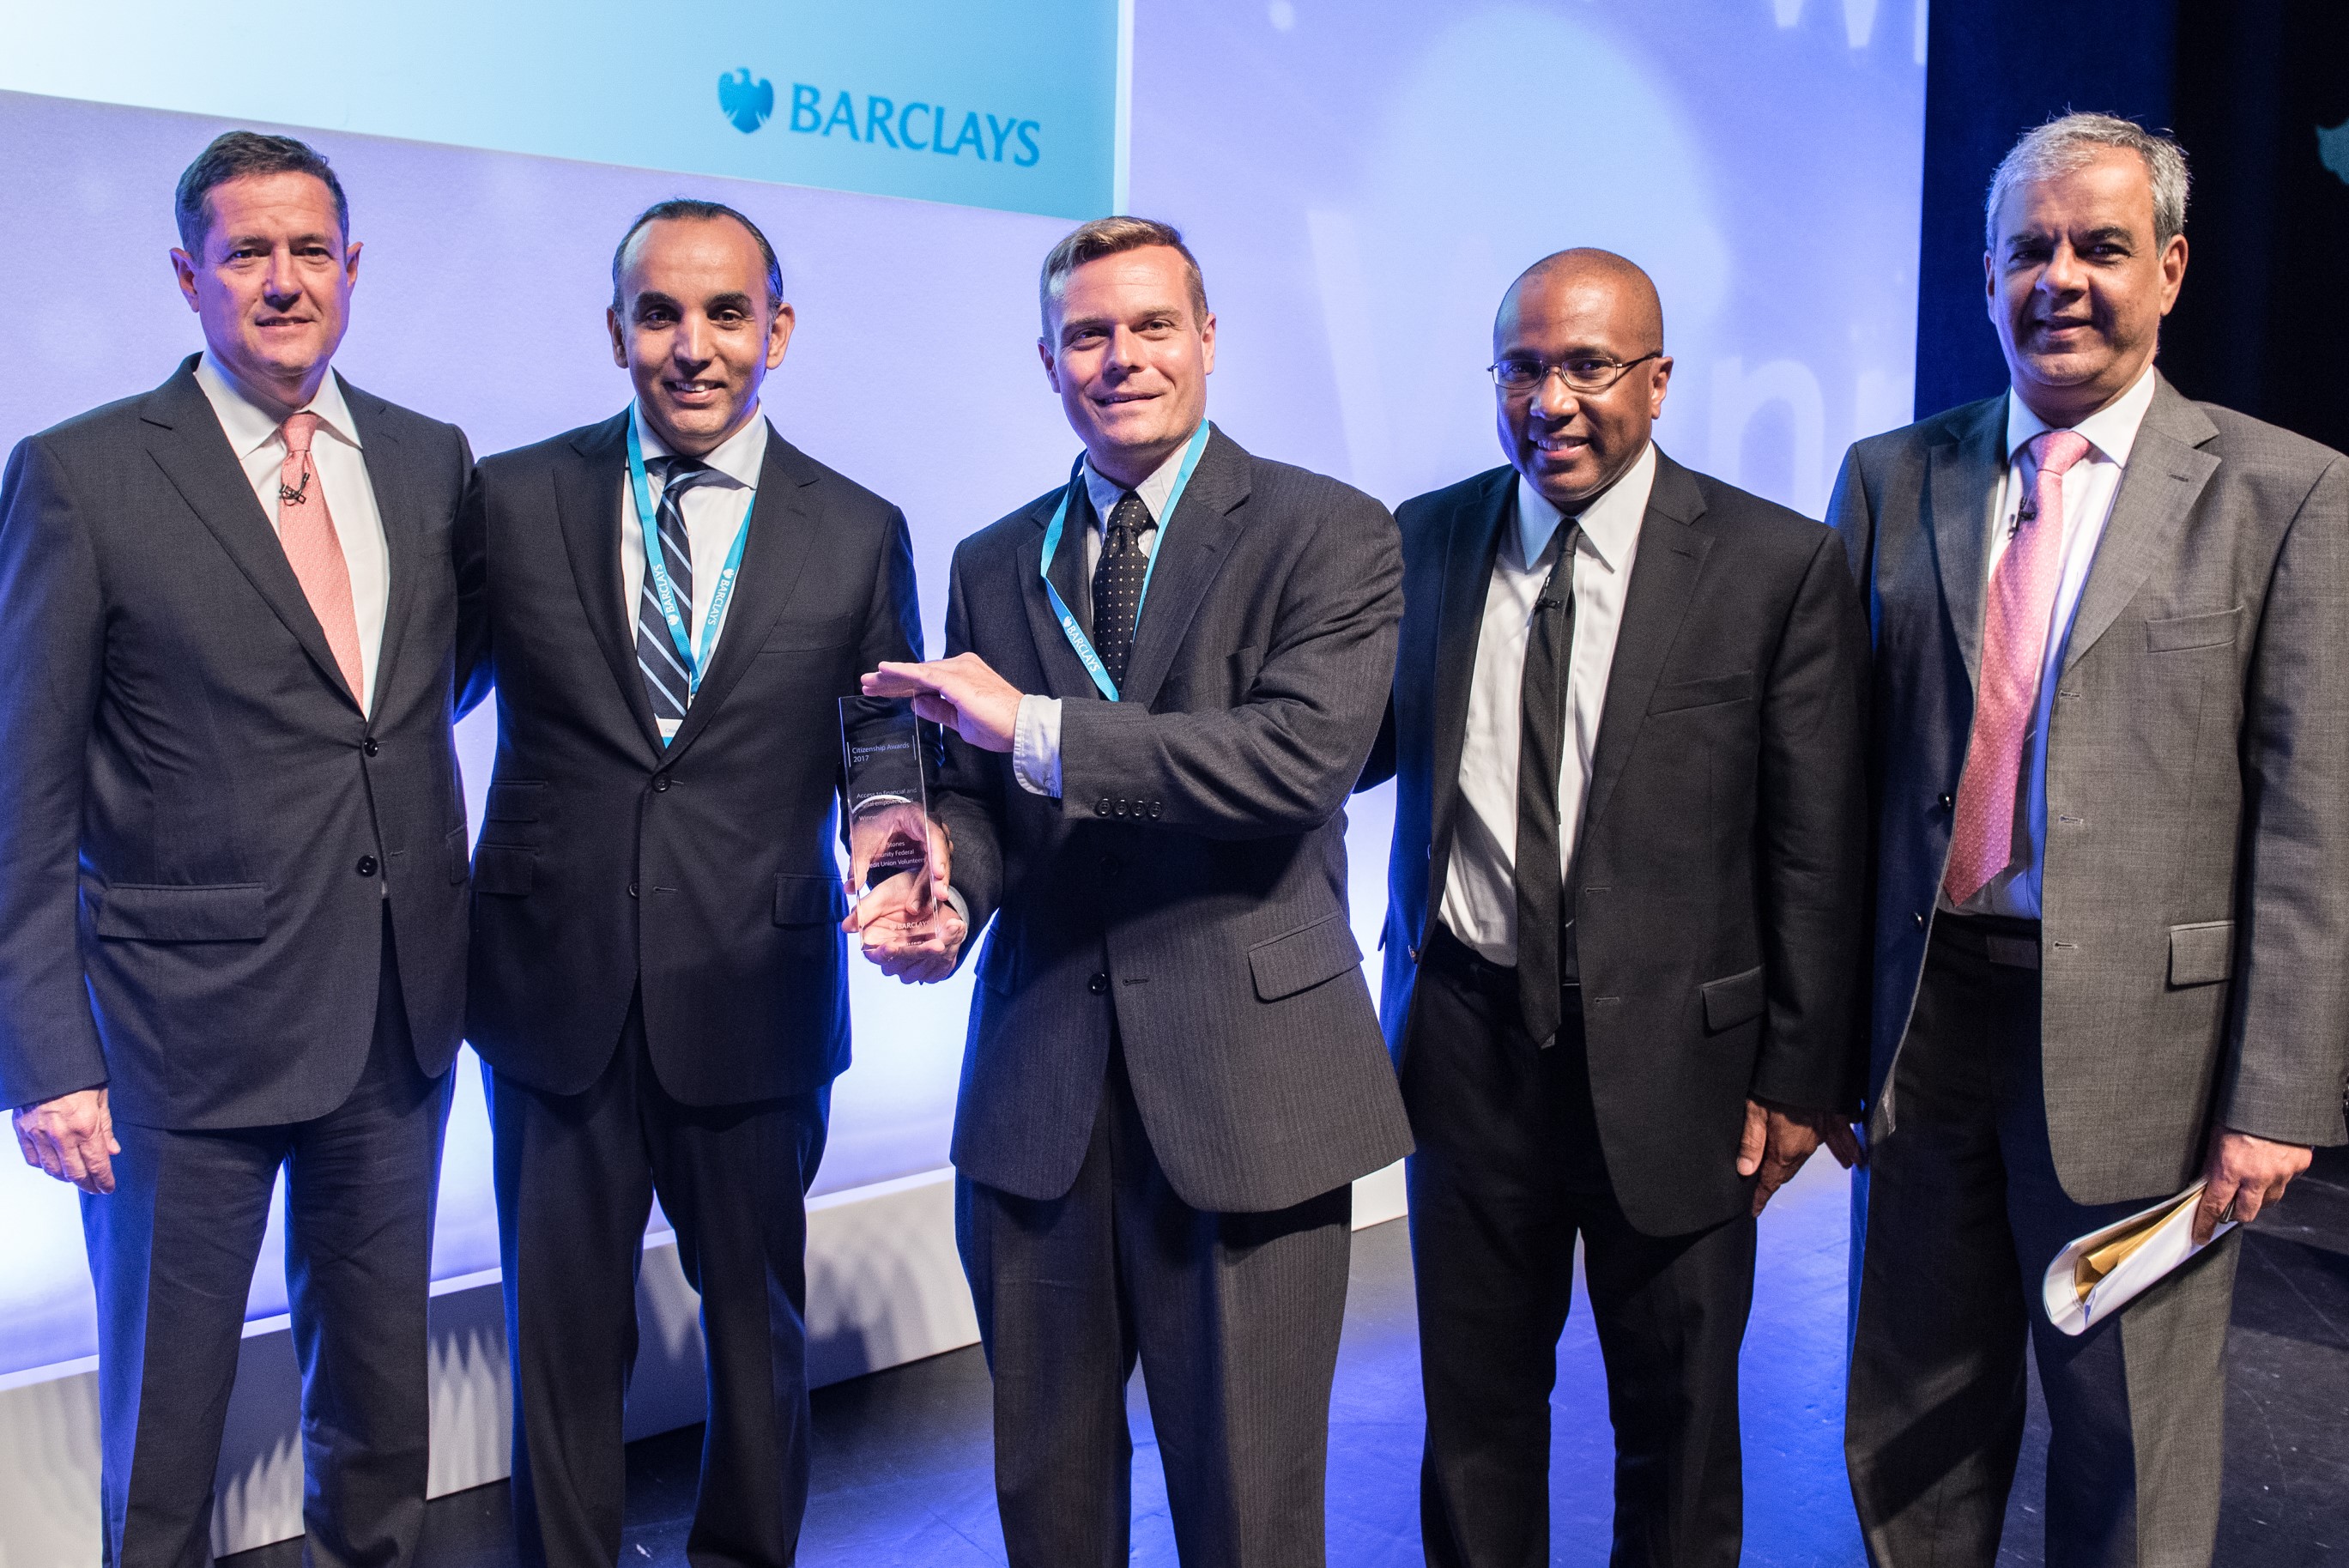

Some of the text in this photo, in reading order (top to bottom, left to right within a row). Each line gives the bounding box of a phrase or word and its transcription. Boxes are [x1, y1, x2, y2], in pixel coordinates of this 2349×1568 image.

[790, 83, 1040, 167] BARCLAYS
[653, 564, 675, 613] BARCLAYS
[707, 579, 730, 626] BARCLAYS
[1067, 626, 1100, 672] BARCLAYS
[851, 744, 886, 754] Citizenship
